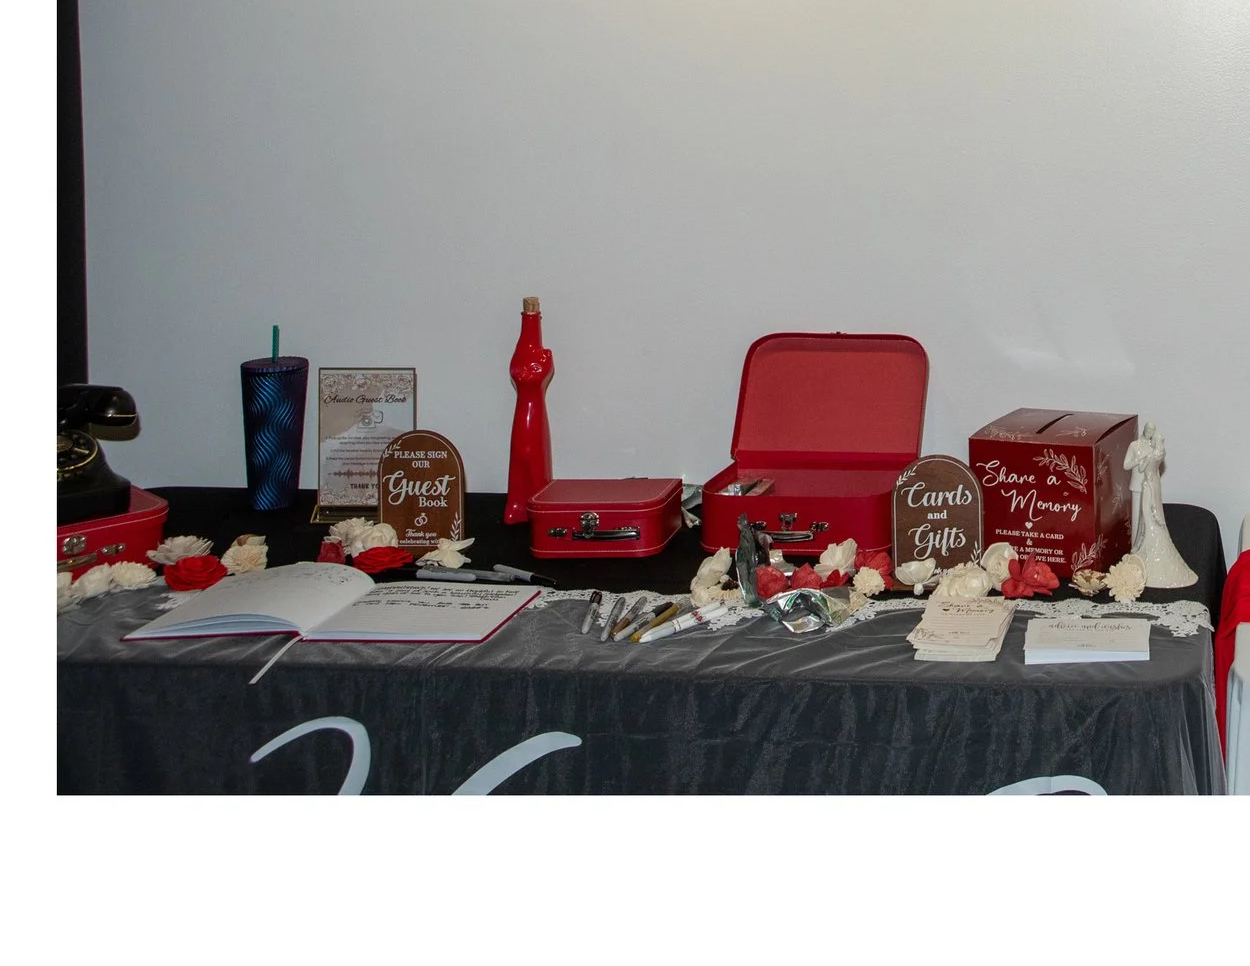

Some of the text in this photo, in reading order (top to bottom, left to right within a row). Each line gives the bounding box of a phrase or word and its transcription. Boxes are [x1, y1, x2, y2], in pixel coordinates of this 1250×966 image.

[324, 395, 407, 404] Audio Guest Book
[394, 451, 448, 459] PLEASE SIGN
[976, 460, 1061, 487] Share a
[383, 471, 456, 505] Guest
[901, 482, 972, 508] Cards
[418, 497, 448, 507] Book
[1001, 489, 1081, 522] Memory
[927, 510, 947, 520] and
[405, 528, 425, 538] Thank
[995, 529, 1021, 537] PLEASE
[1021, 530, 1039, 538] TAKE
[908, 523, 966, 560] Gifts
[1026, 538, 1033, 546] &
[1025, 547, 1053, 555] MEMORY
[1047, 556, 1067, 564] HERE.
